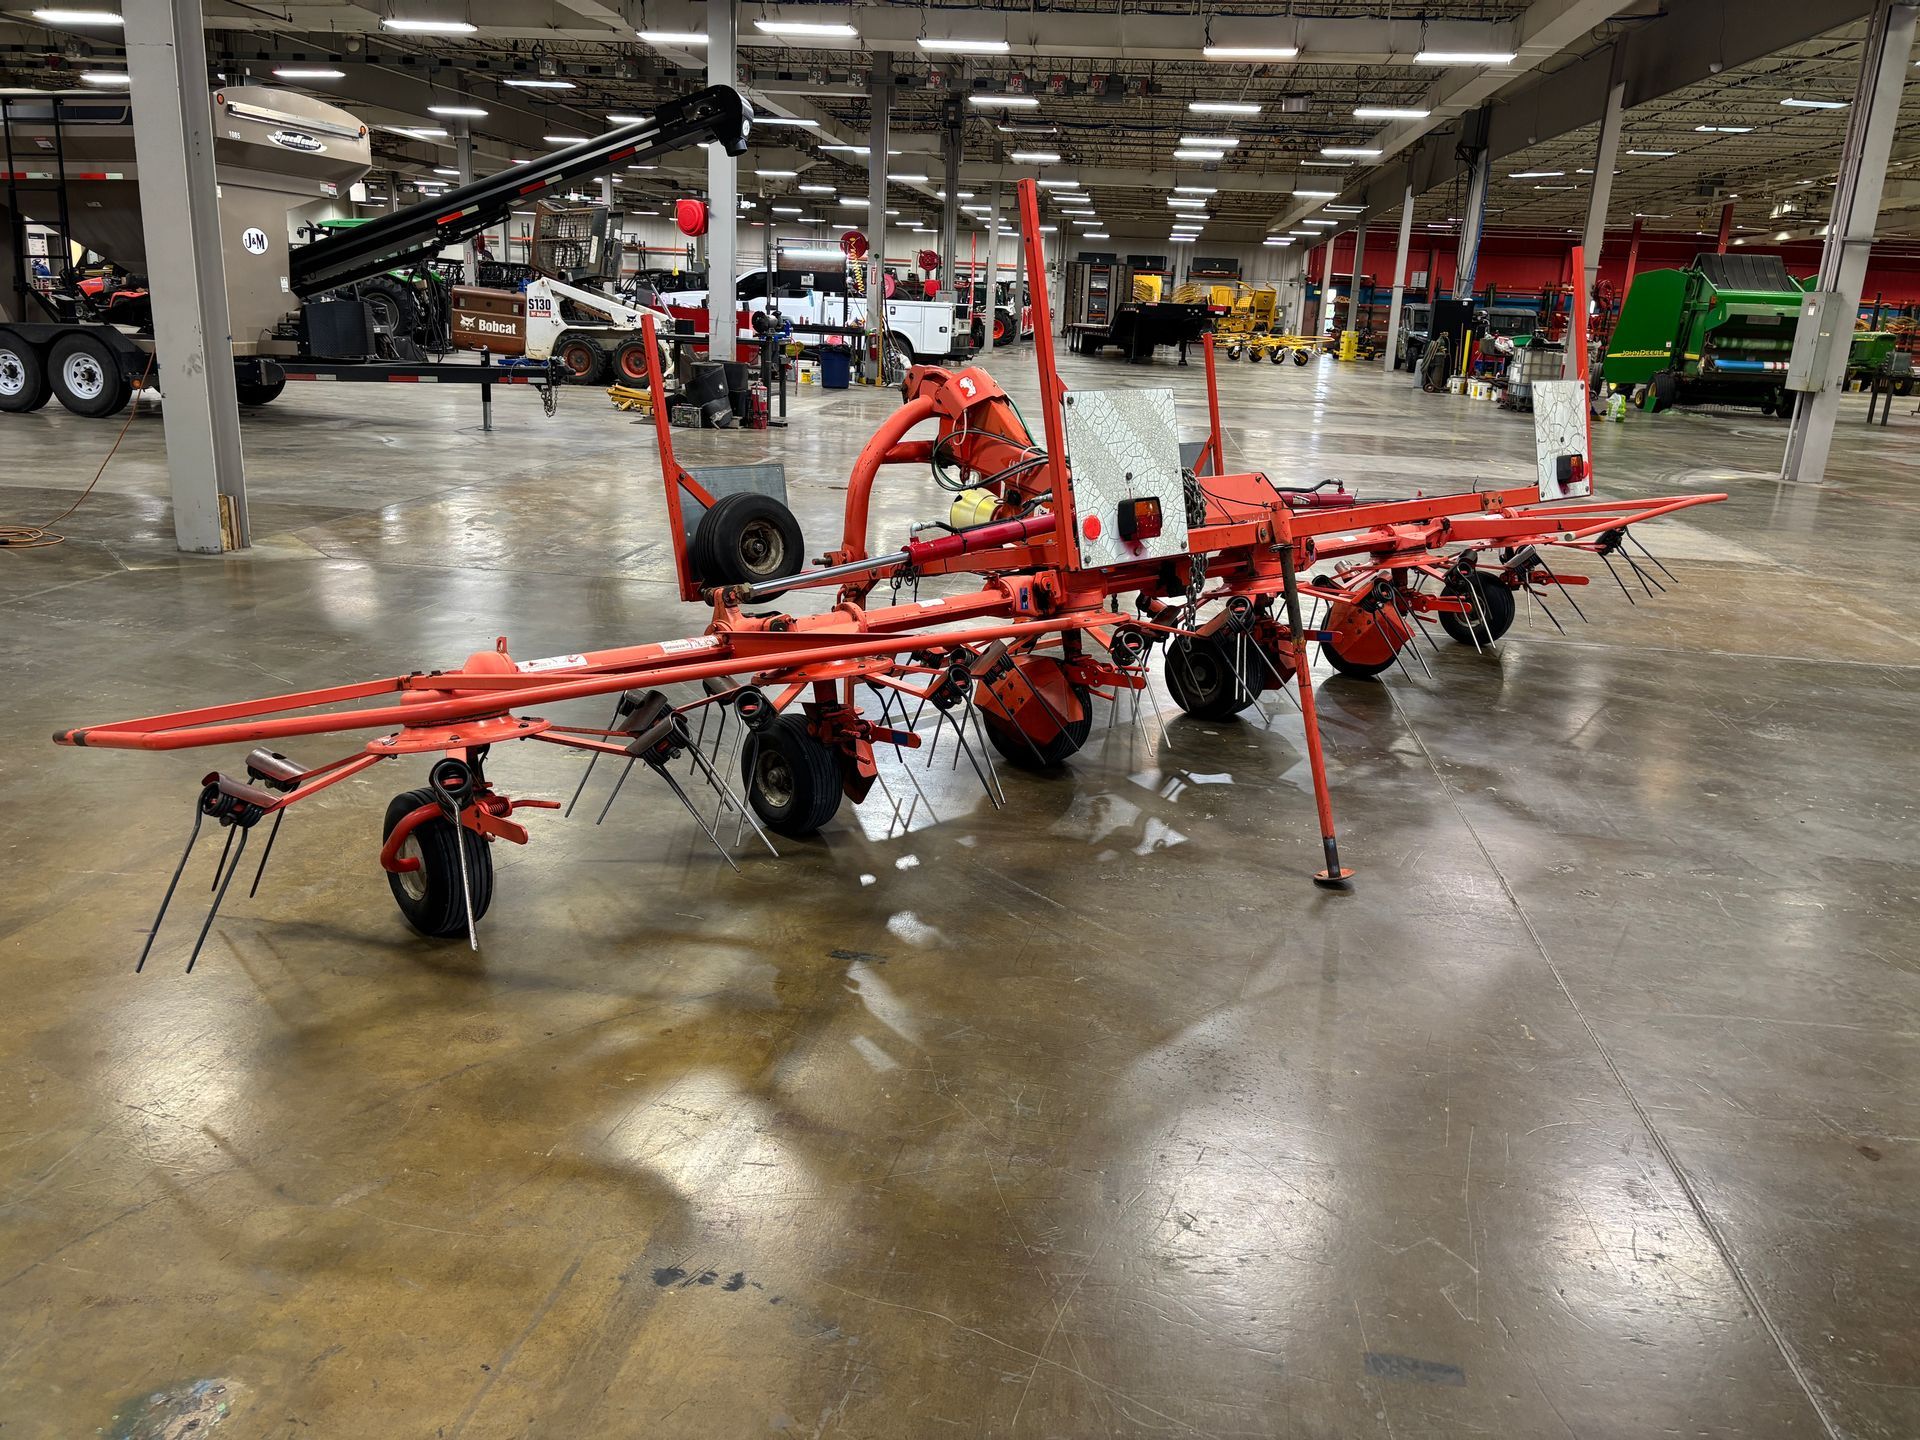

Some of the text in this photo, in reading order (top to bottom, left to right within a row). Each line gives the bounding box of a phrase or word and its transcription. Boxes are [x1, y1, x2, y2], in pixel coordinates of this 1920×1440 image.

[244, 232, 265, 250] J&M
[528, 298, 551, 311] S130
[478, 319, 516, 335] Bobcat
